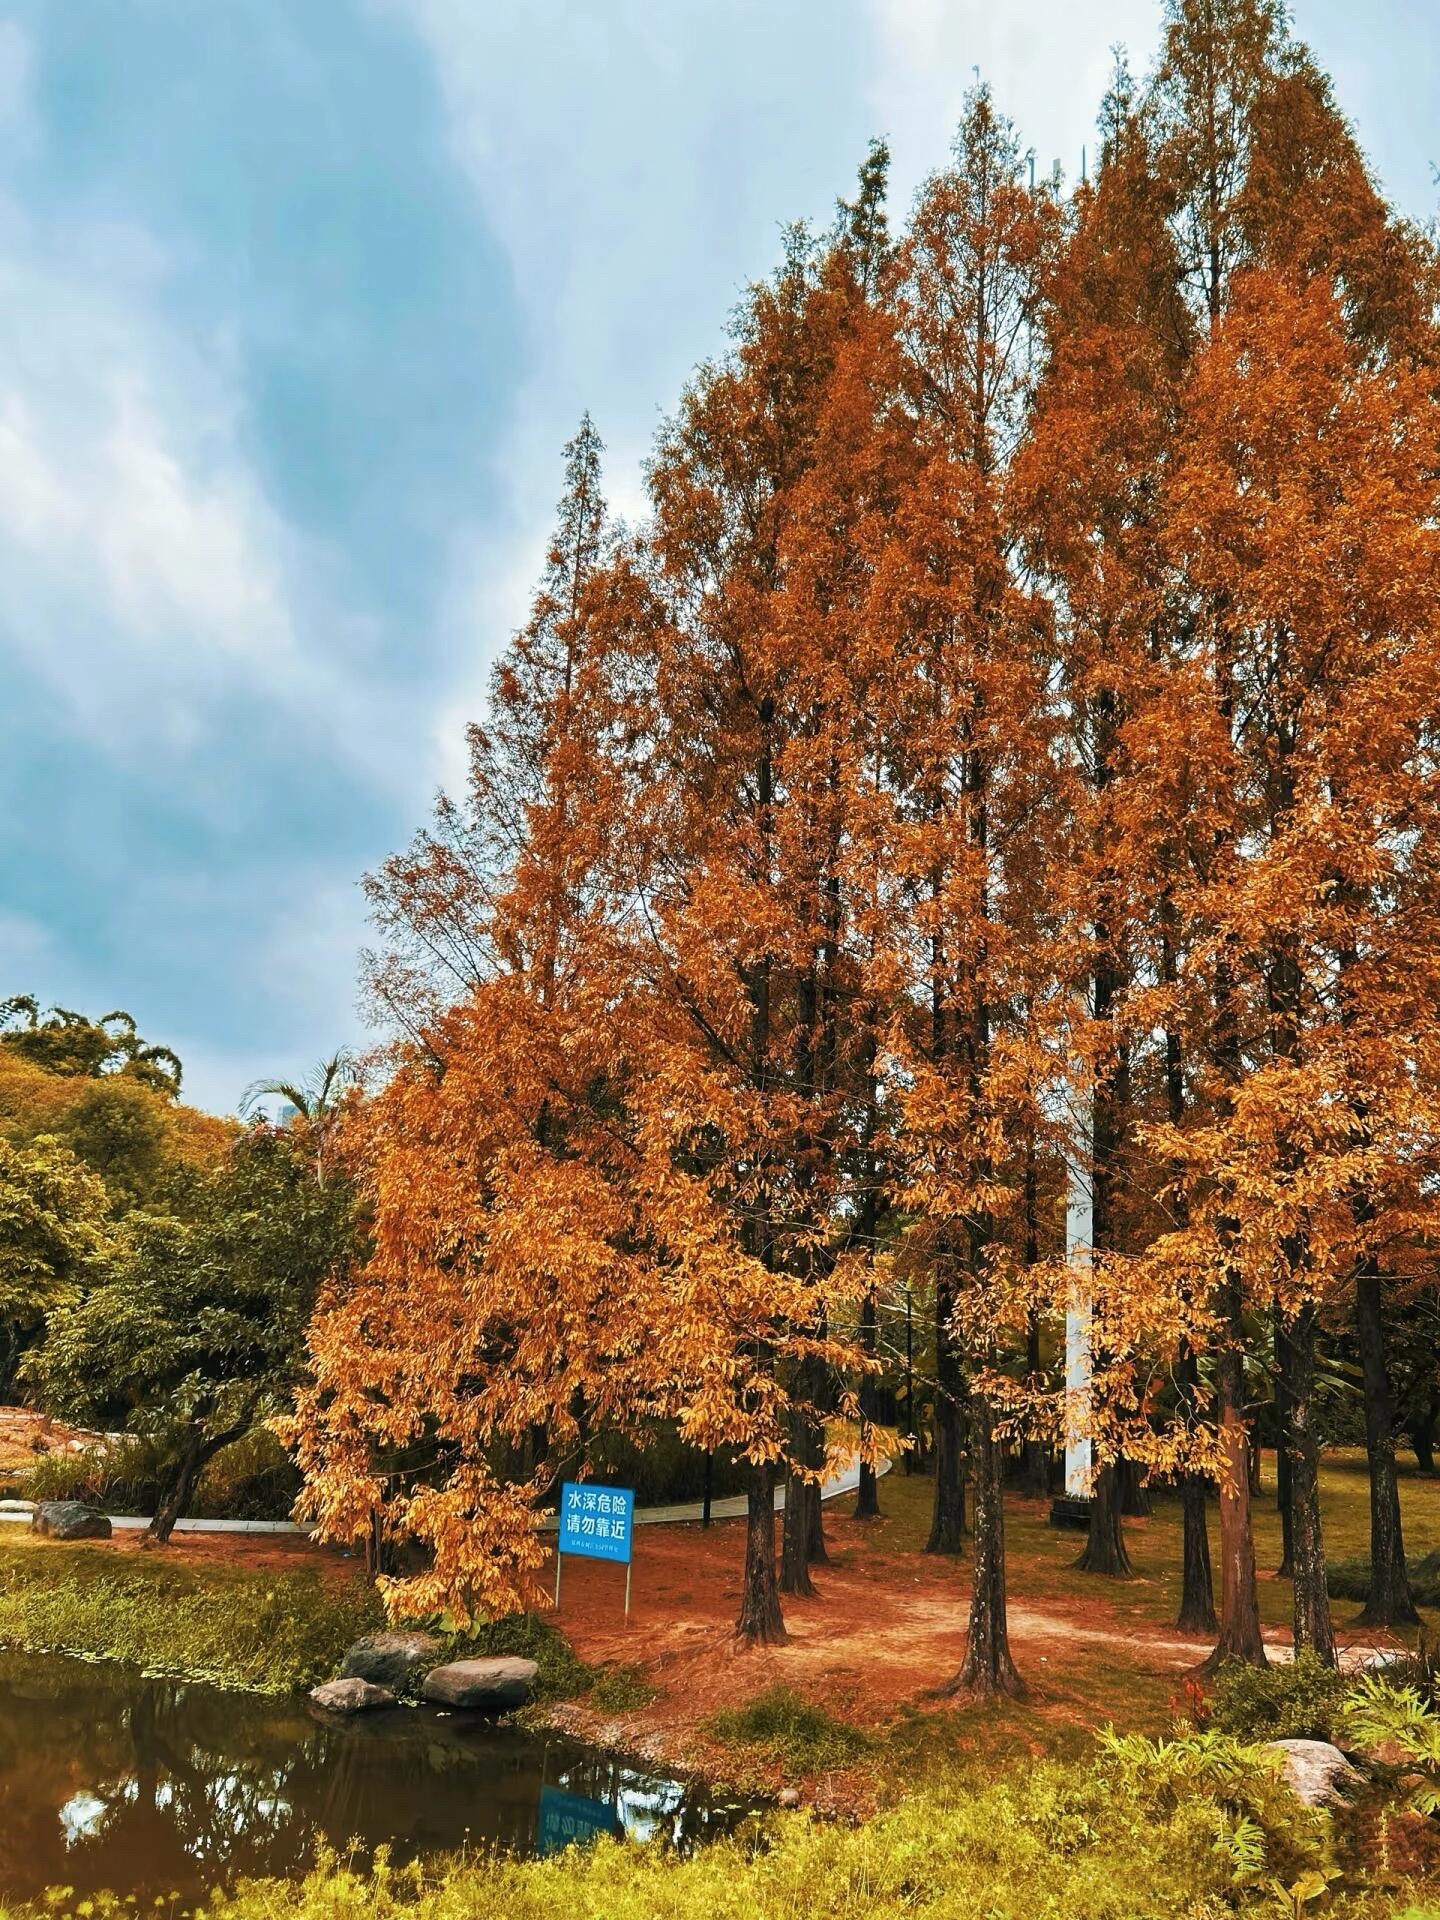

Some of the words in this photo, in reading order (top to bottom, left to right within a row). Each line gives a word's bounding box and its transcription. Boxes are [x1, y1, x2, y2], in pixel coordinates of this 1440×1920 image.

[568, 1490, 627, 1515] 水深危险
[567, 1514, 625, 1539] 请勿靠近
